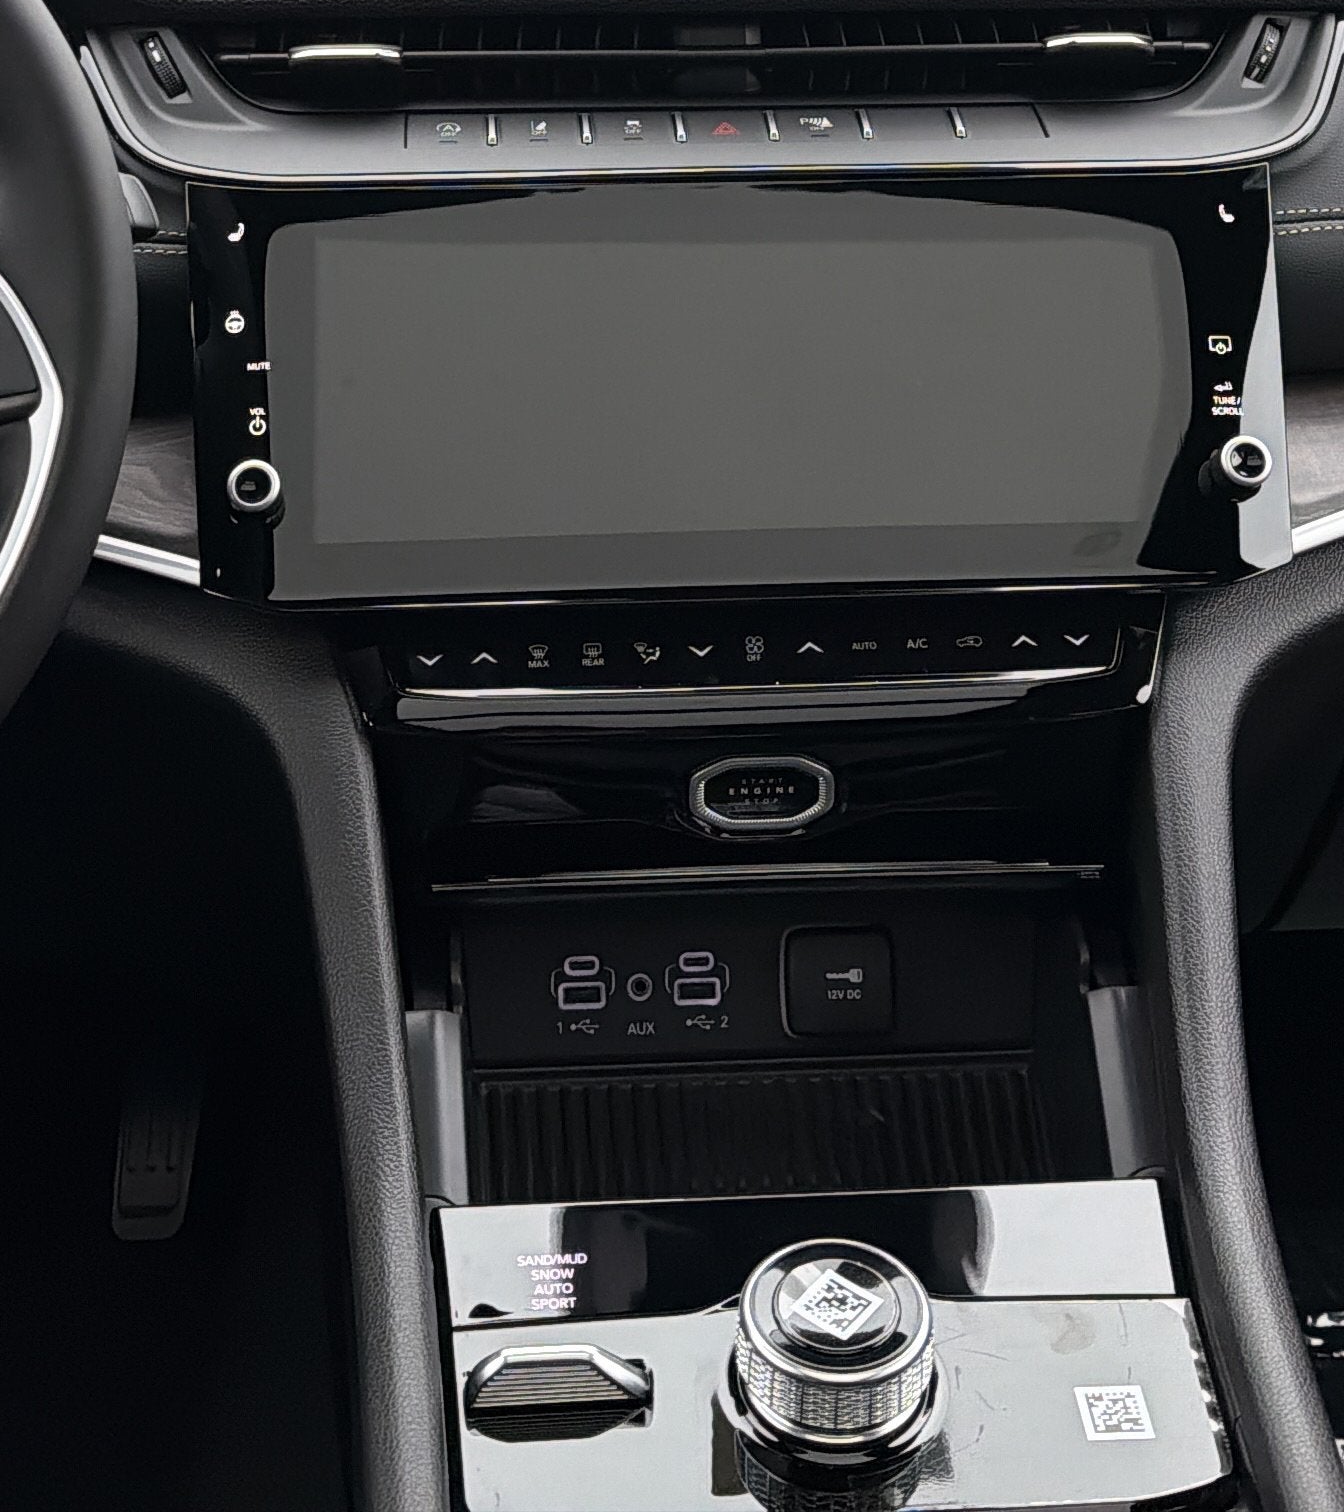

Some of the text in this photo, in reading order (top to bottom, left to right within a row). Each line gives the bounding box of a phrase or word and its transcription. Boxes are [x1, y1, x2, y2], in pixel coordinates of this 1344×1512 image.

[246, 361, 272, 371] MUTE
[249, 407, 266, 416] VOL
[1211, 406, 1245, 416] SCROLL
[852, 641, 878, 650] AUTO
[906, 637, 929, 649] A/C
[581, 658, 605, 667] REAR
[746, 654, 761, 662] OFF
[528, 660, 550, 668] MAX
[728, 785, 795, 796] ENGINE
[827, 989, 862, 1000] 12V DC
[627, 1021, 655, 1035] AUX
[720, 1016, 729, 1029] 2
[516, 1252, 588, 1267] SAND/MUD
[530, 1267, 575, 1281] SNOW
[533, 1282, 574, 1295] AUTO
[531, 1296, 577, 1310] SPORT
